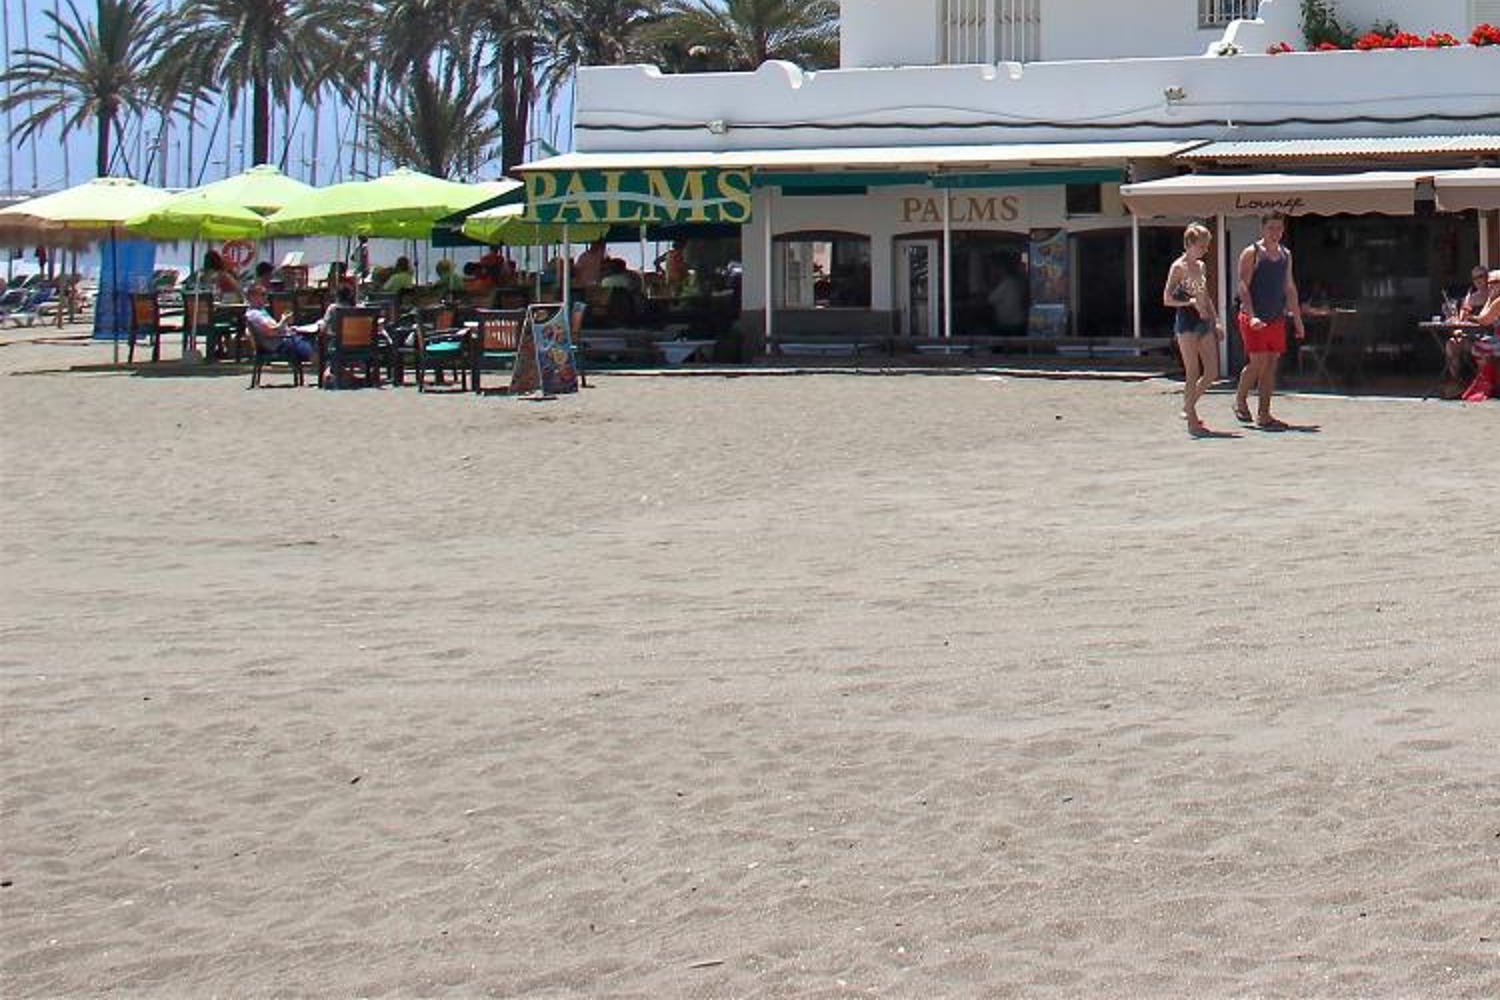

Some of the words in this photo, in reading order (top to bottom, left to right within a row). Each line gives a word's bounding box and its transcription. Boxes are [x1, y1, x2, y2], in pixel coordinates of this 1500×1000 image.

[514, 168, 752, 224] PALMS
[899, 195, 1019, 223] PALMS
[1235, 192, 1305, 213] Lounge
